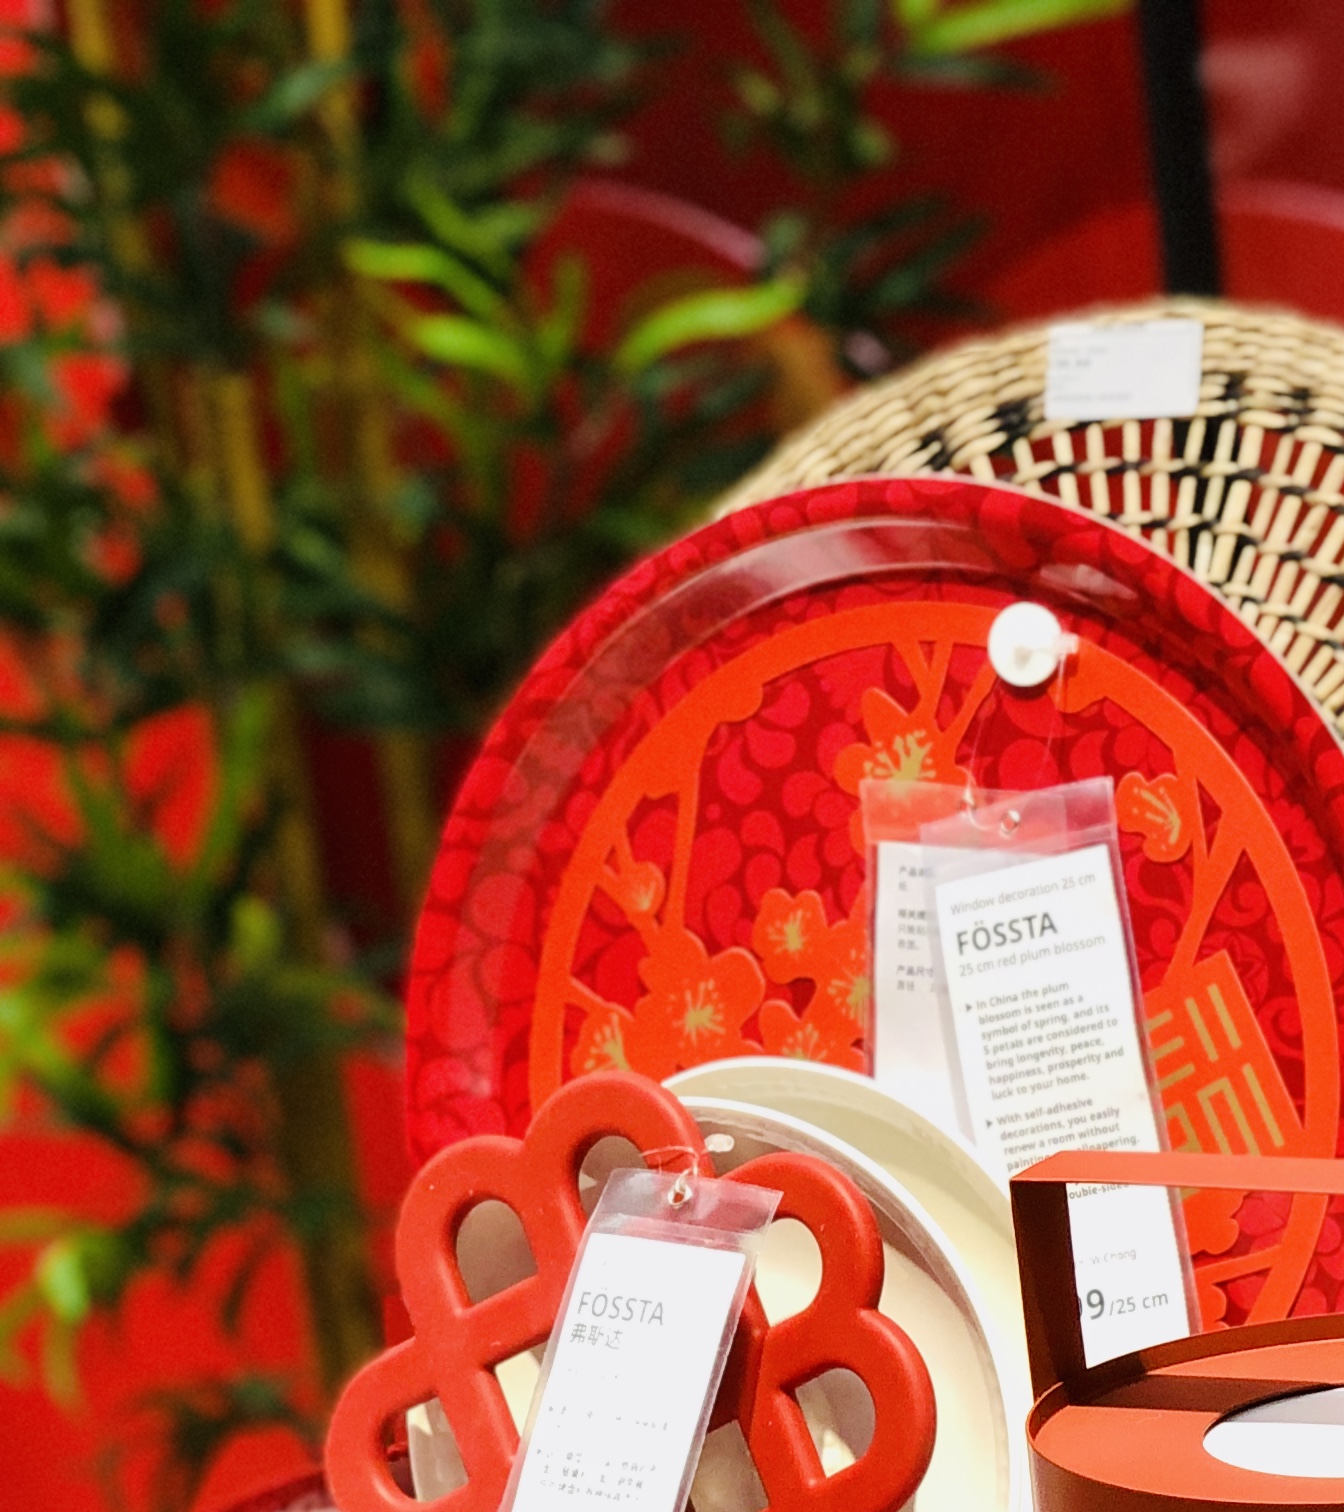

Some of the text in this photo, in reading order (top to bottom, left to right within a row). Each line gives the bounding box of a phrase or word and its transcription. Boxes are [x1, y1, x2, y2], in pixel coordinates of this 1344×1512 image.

[950, 873, 1096, 915] Window decoration 25 cm
[956, 912, 1058, 955] FÖSSTA
[959, 935, 1106, 977] 25 cm red plum blossom
[976, 981, 1070, 1010] In China the plum
[978, 994, 1084, 1025] blossom is seen as a
[981, 1003, 1110, 1042] symbol of spring, and its
[983, 1017, 1118, 1057] 5 petals are considered to
[985, 1037, 1105, 1072] bring longevity, peace,
[988, 1046, 1124, 1086] happiness, prosperity and
[991, 1071, 1090, 1101] luck to your home.
[996, 1097, 1094, 1126] With self-adhesive
[1000, 1107, 1120, 1141] decorations, you easily
[1003, 1122, 1120, 1155] renew a room without
[1076, 1135, 1140, 1151] llpapering.
[577, 1286, 663, 1326] FÖSSTA
[1078, 1289, 1169, 1321] 9/25 cm
